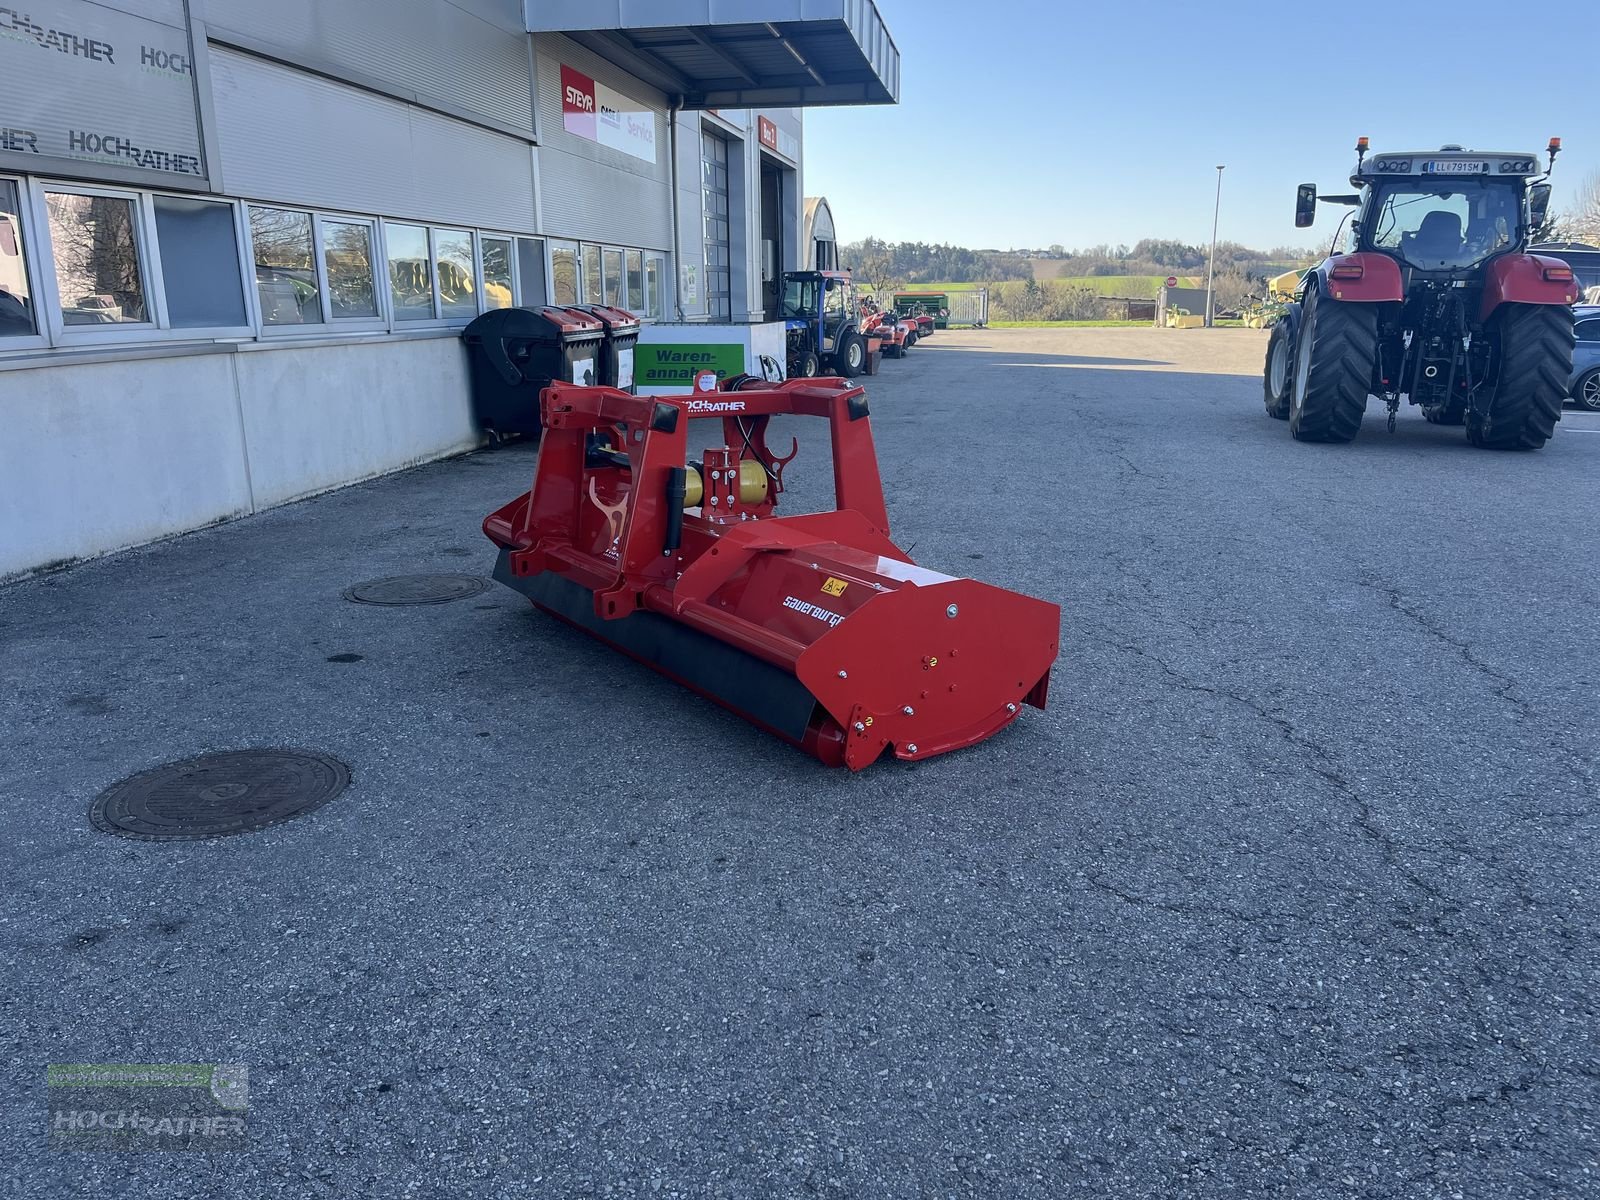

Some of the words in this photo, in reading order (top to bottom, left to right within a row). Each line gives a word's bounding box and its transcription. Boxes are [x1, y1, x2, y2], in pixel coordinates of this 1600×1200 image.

[566, 85, 593, 112] STEYR
[627, 115, 653, 143] Service
[69, 130, 200, 175] HOCHRATHER
[1452, 163, 1479, 171] 791SM
[656, 350, 717, 362] Waren-
[646, 367, 726, 379] annahe
